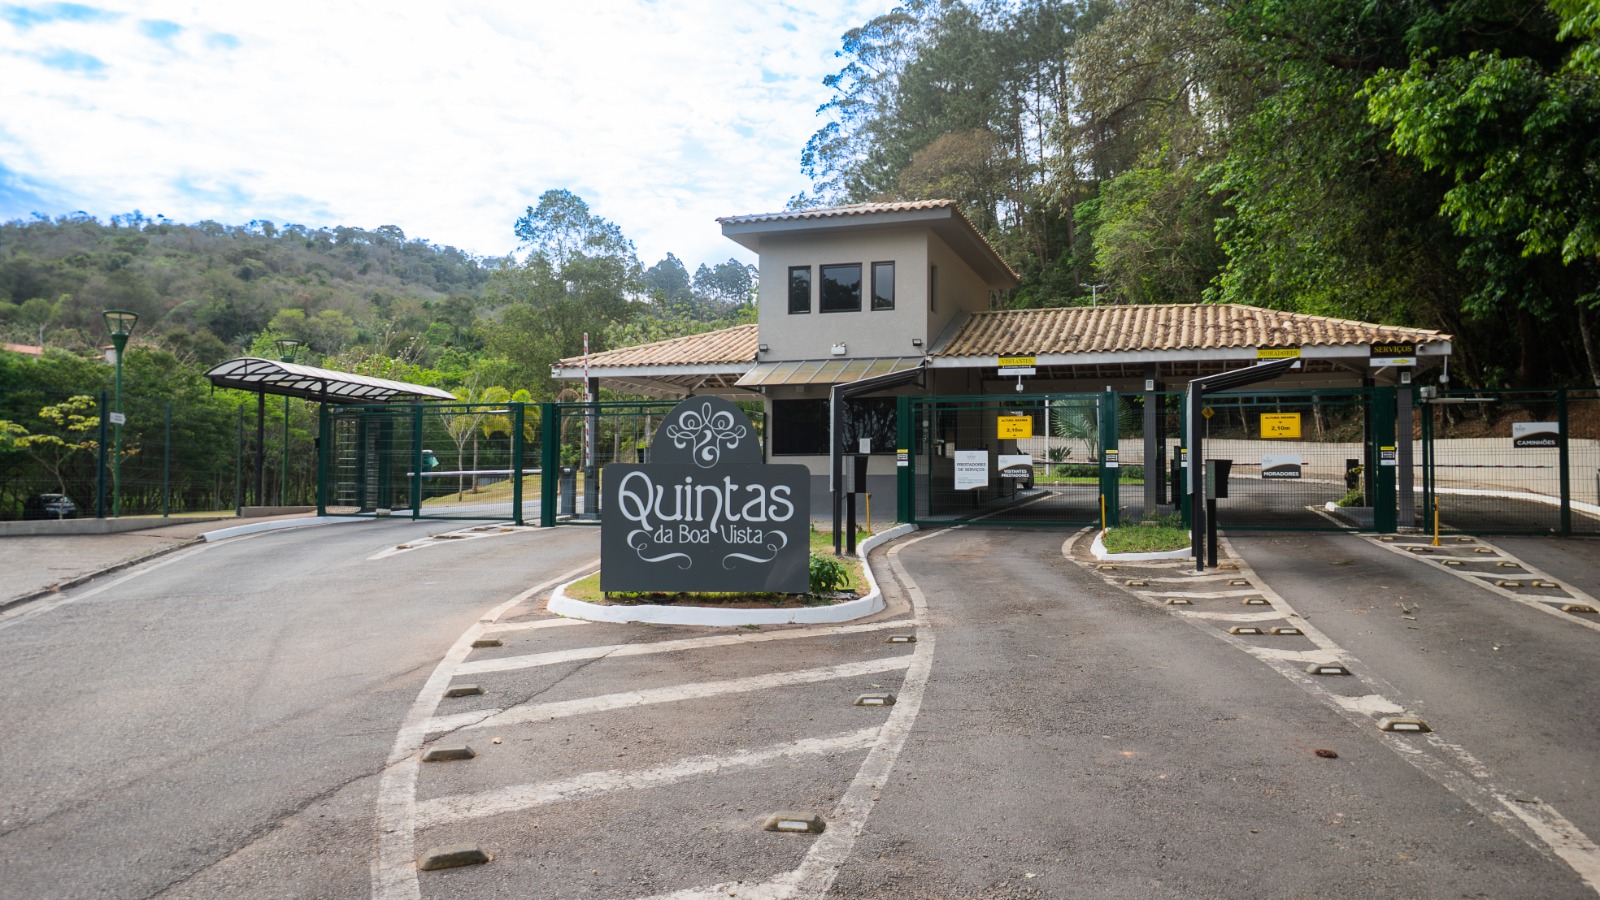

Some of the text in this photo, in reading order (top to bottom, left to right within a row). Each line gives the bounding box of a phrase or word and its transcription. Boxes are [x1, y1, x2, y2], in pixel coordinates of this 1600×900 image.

[1374, 346, 1412, 354] SERVIÇOS
[618, 470, 794, 534] Quintas
[654, 524, 763, 544] da Boa Vista
